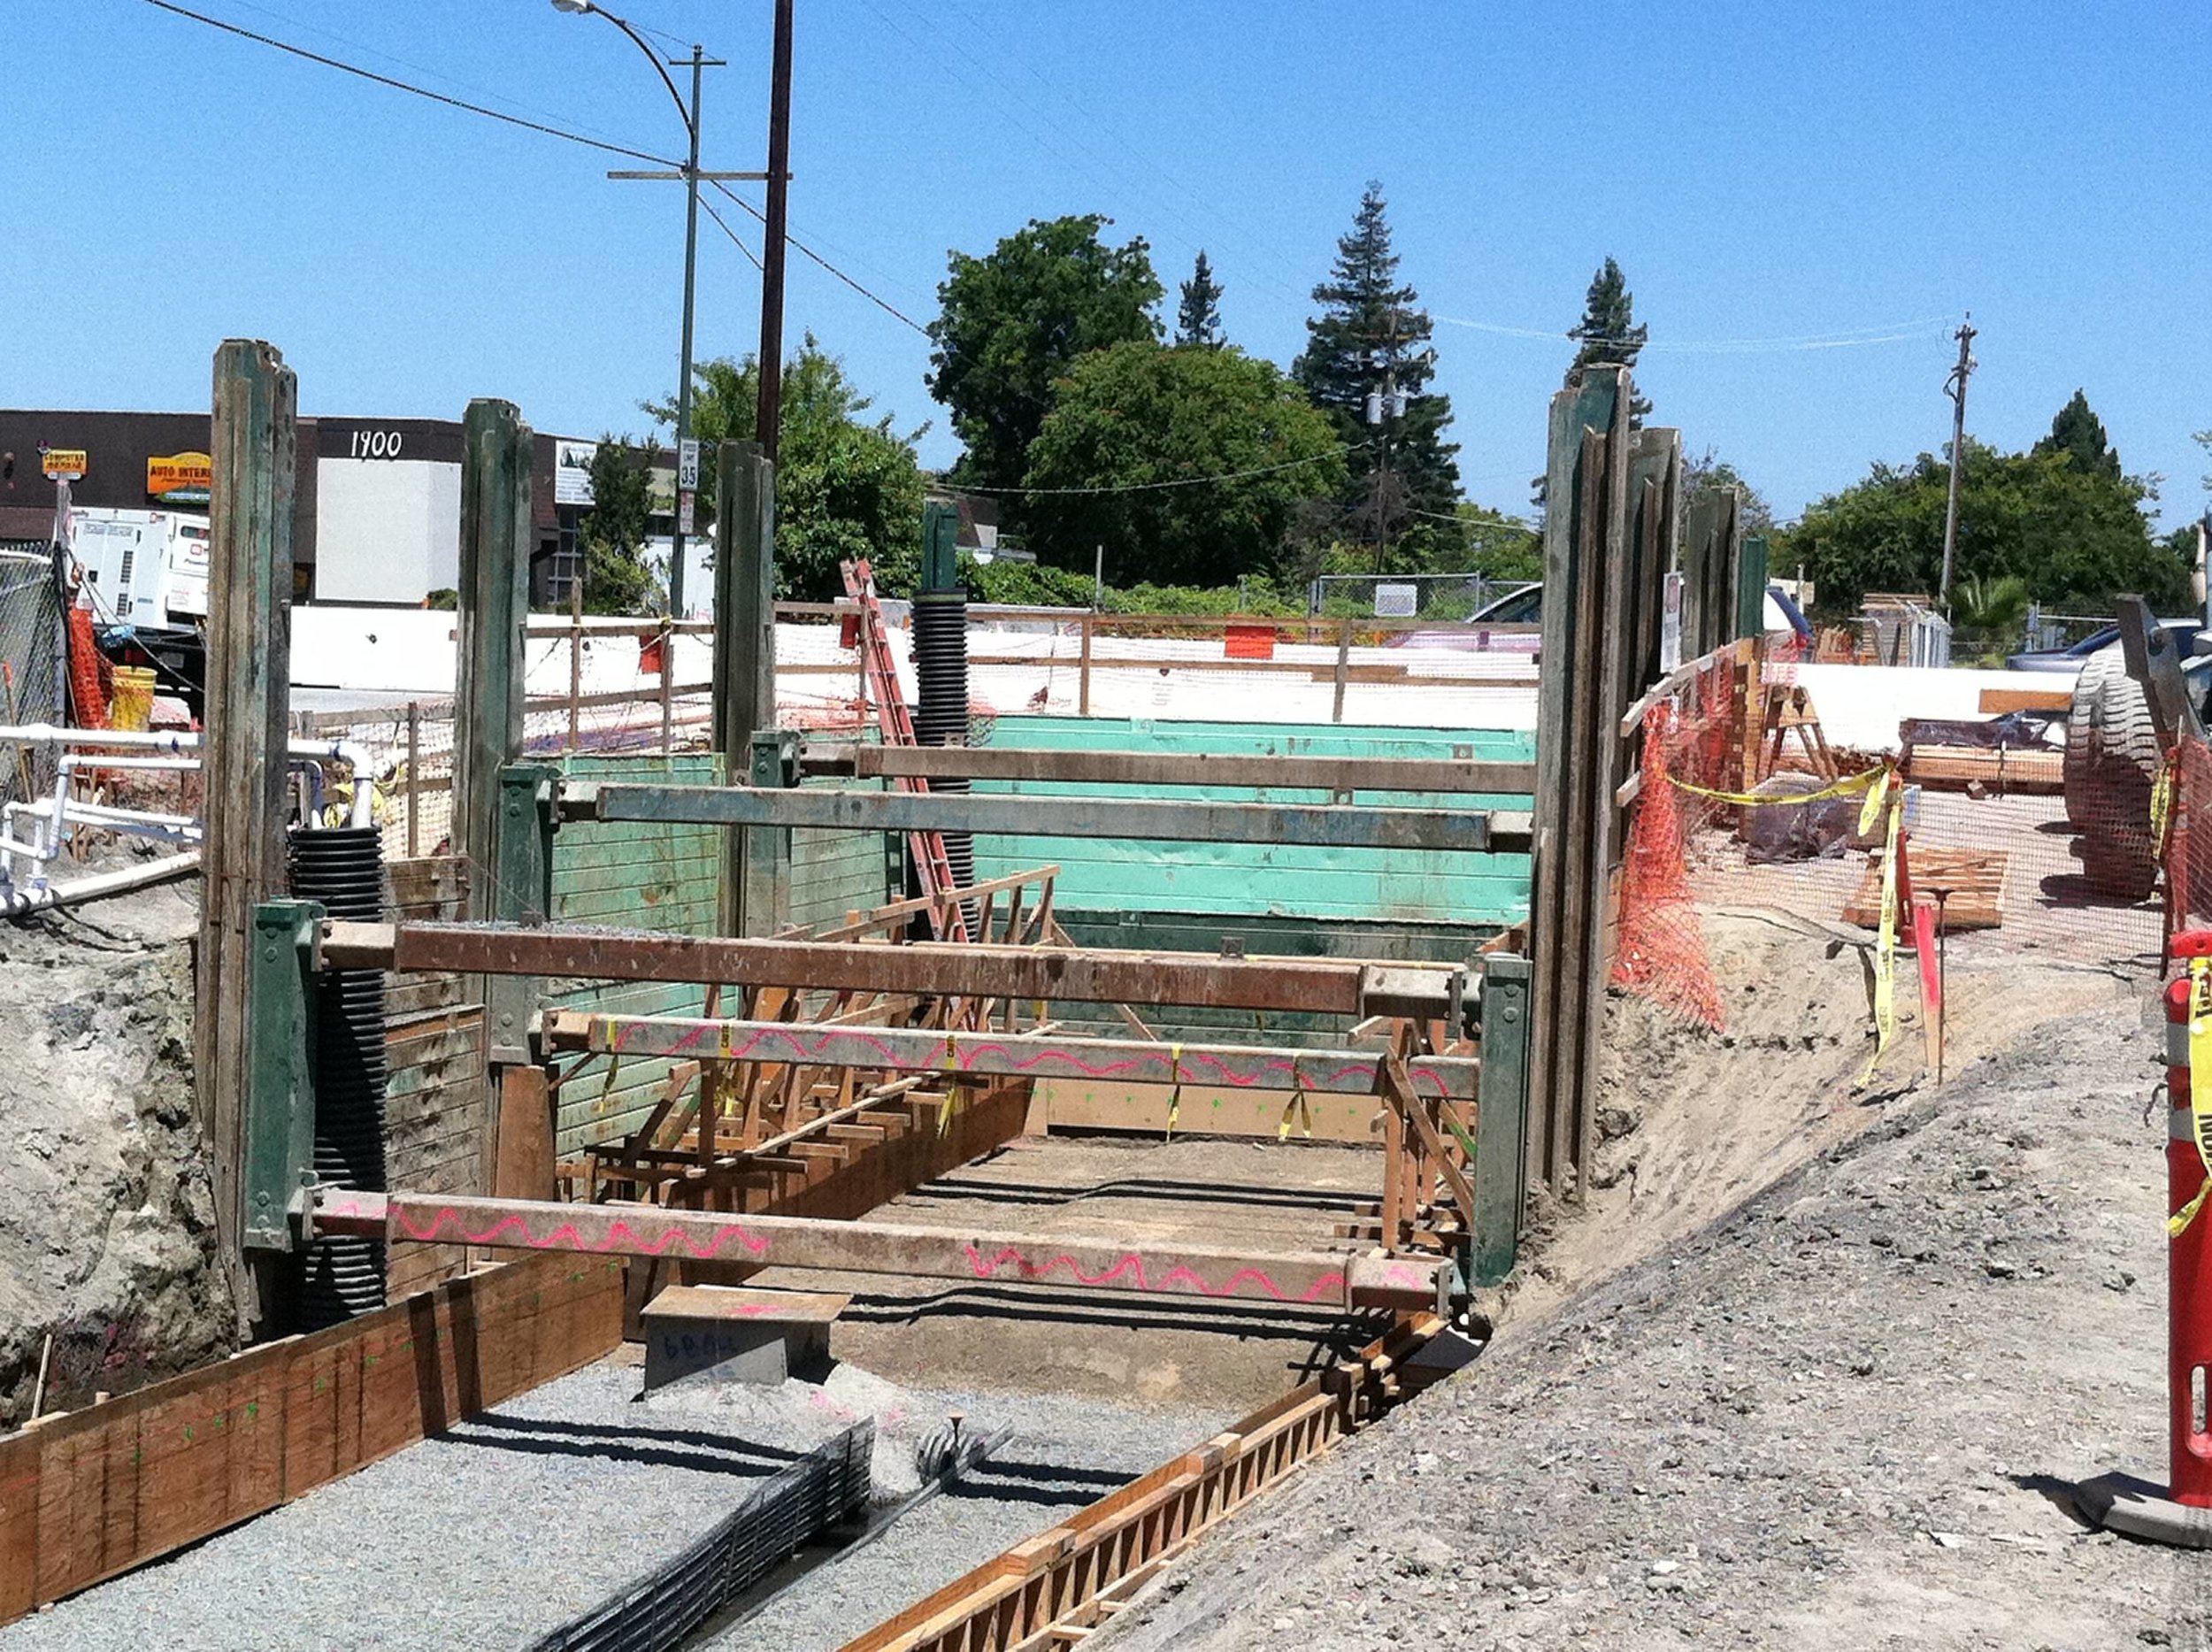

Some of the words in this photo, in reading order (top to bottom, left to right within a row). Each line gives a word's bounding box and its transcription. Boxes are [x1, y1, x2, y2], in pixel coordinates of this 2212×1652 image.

[351, 431, 402, 457] 1900
[150, 466, 175, 477] AUTO
[681, 466, 696, 485] 35
